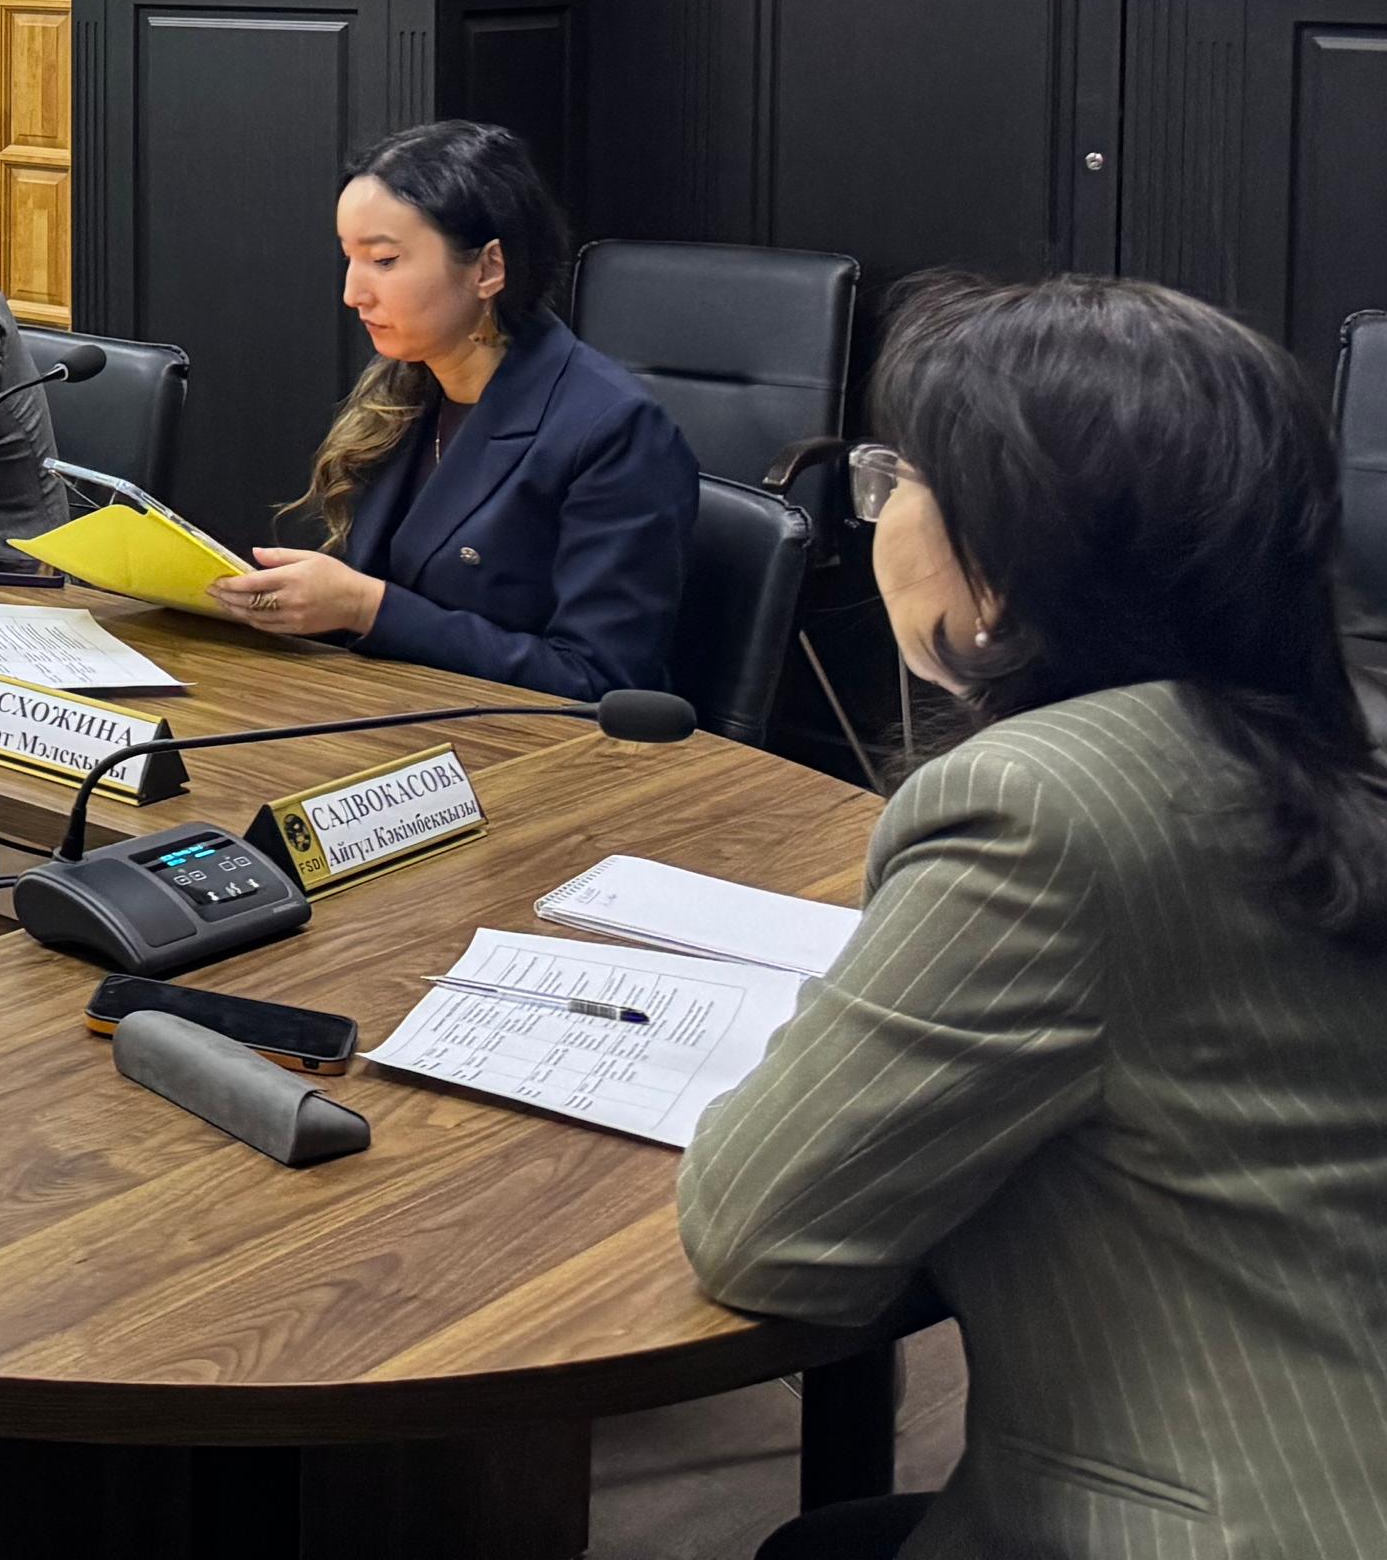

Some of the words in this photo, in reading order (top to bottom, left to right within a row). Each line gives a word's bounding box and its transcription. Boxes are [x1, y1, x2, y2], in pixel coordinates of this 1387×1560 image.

[16, 731, 127, 781] Мэлскыы
[312, 761, 465, 832] САДВОКАСОВА
[298, 855, 326, 875] FSDI
[329, 837, 376, 867] Айгүл
